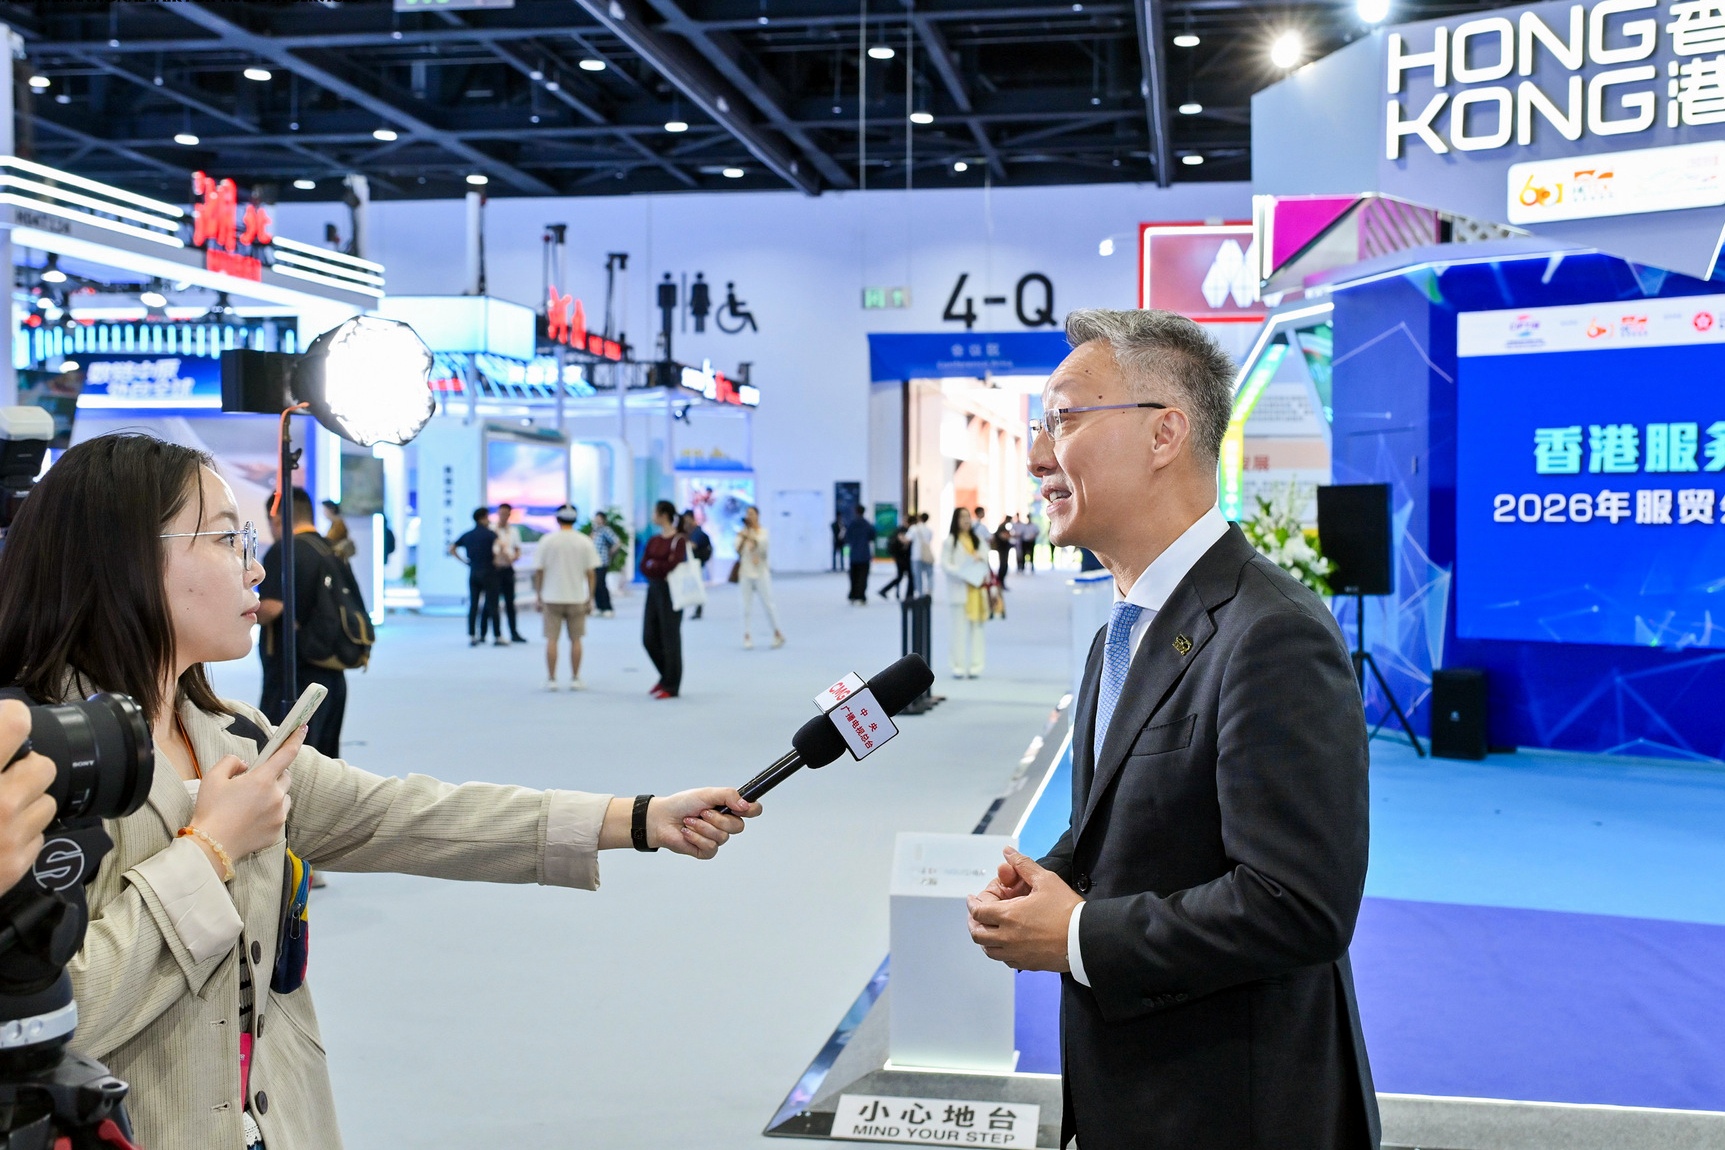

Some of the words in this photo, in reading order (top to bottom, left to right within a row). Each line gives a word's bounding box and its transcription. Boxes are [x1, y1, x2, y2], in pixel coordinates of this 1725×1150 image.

[1387, 0, 1657, 94] HONG
[1386, 65, 1656, 160] KONG
[943, 272, 1058, 330] 4-Q
[1494, 488, 1725, 524] 2026年服贸
[829, 681, 851, 701] CMG
[840, 705, 874, 749] 广播电视总台
[72, 760, 95, 768] SONY
[858, 1100, 1017, 1131] 小心地台
[853, 1125, 900, 1137] MIND
[907, 1127, 960, 1142] YOUR
[966, 1131, 1016, 1144] STEP
